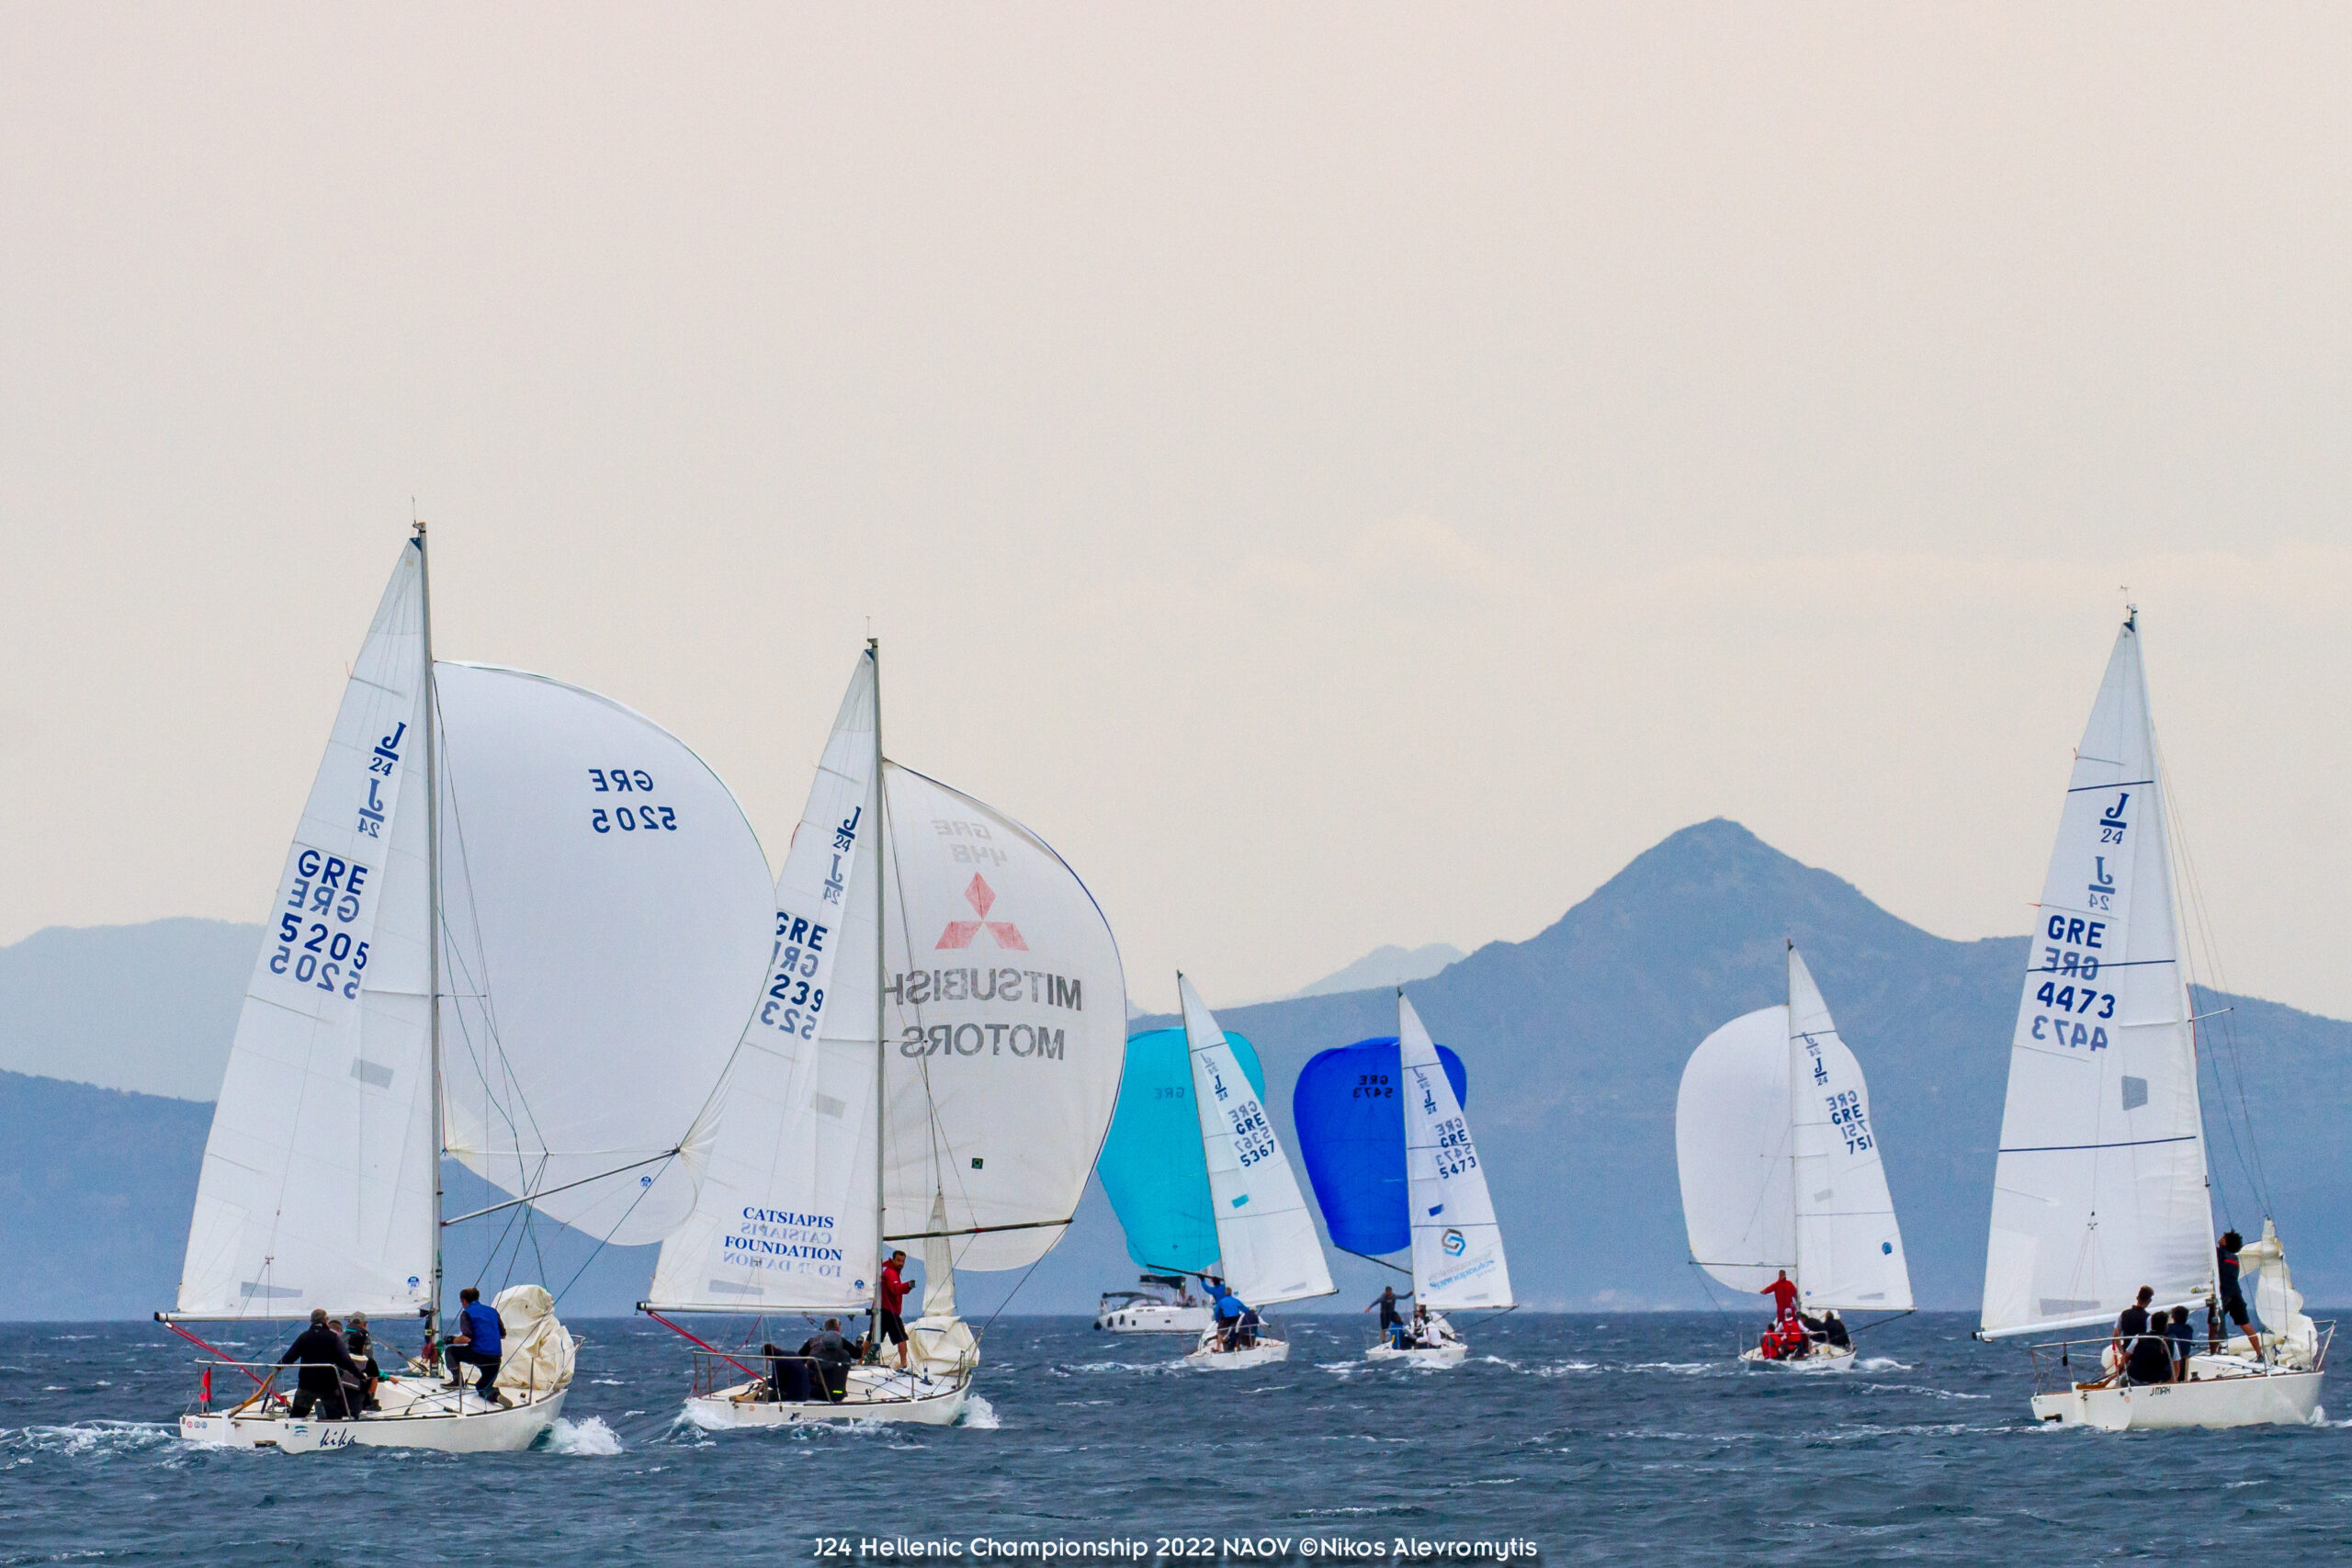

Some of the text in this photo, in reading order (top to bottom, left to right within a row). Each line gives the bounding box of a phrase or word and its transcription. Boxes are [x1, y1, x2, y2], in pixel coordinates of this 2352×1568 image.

[381, 721, 407, 750] J
[368, 756, 393, 777] 24
[2105, 792, 2130, 819] J
[842, 806, 862, 831] J
[832, 833, 852, 852] 24
[2100, 829, 2123, 845] 24
[298, 849, 368, 897] GRE
[278, 912, 369, 971] 5205
[775, 911, 829, 952] GRE
[2047, 914, 2106, 949] GRE
[769, 974, 824, 1012] 239
[2036, 980, 2116, 1020] 4473
[1816, 1076, 1828, 1087] 24
[1217, 1091, 1228, 1101] 24
[1236, 1112, 1265, 1135] GRE
[1831, 1104, 1863, 1125] GRE
[1441, 1129, 1467, 1148] GRE
[1846, 1134, 1873, 1155] 751
[1239, 1139, 1274, 1168] 5367
[1440, 1156, 1476, 1179] 5473
[742, 1206, 834, 1229] CATSIAPIS
[724, 1235, 842, 1262] FOUNDATION
[320, 1427, 356, 1448] kika
